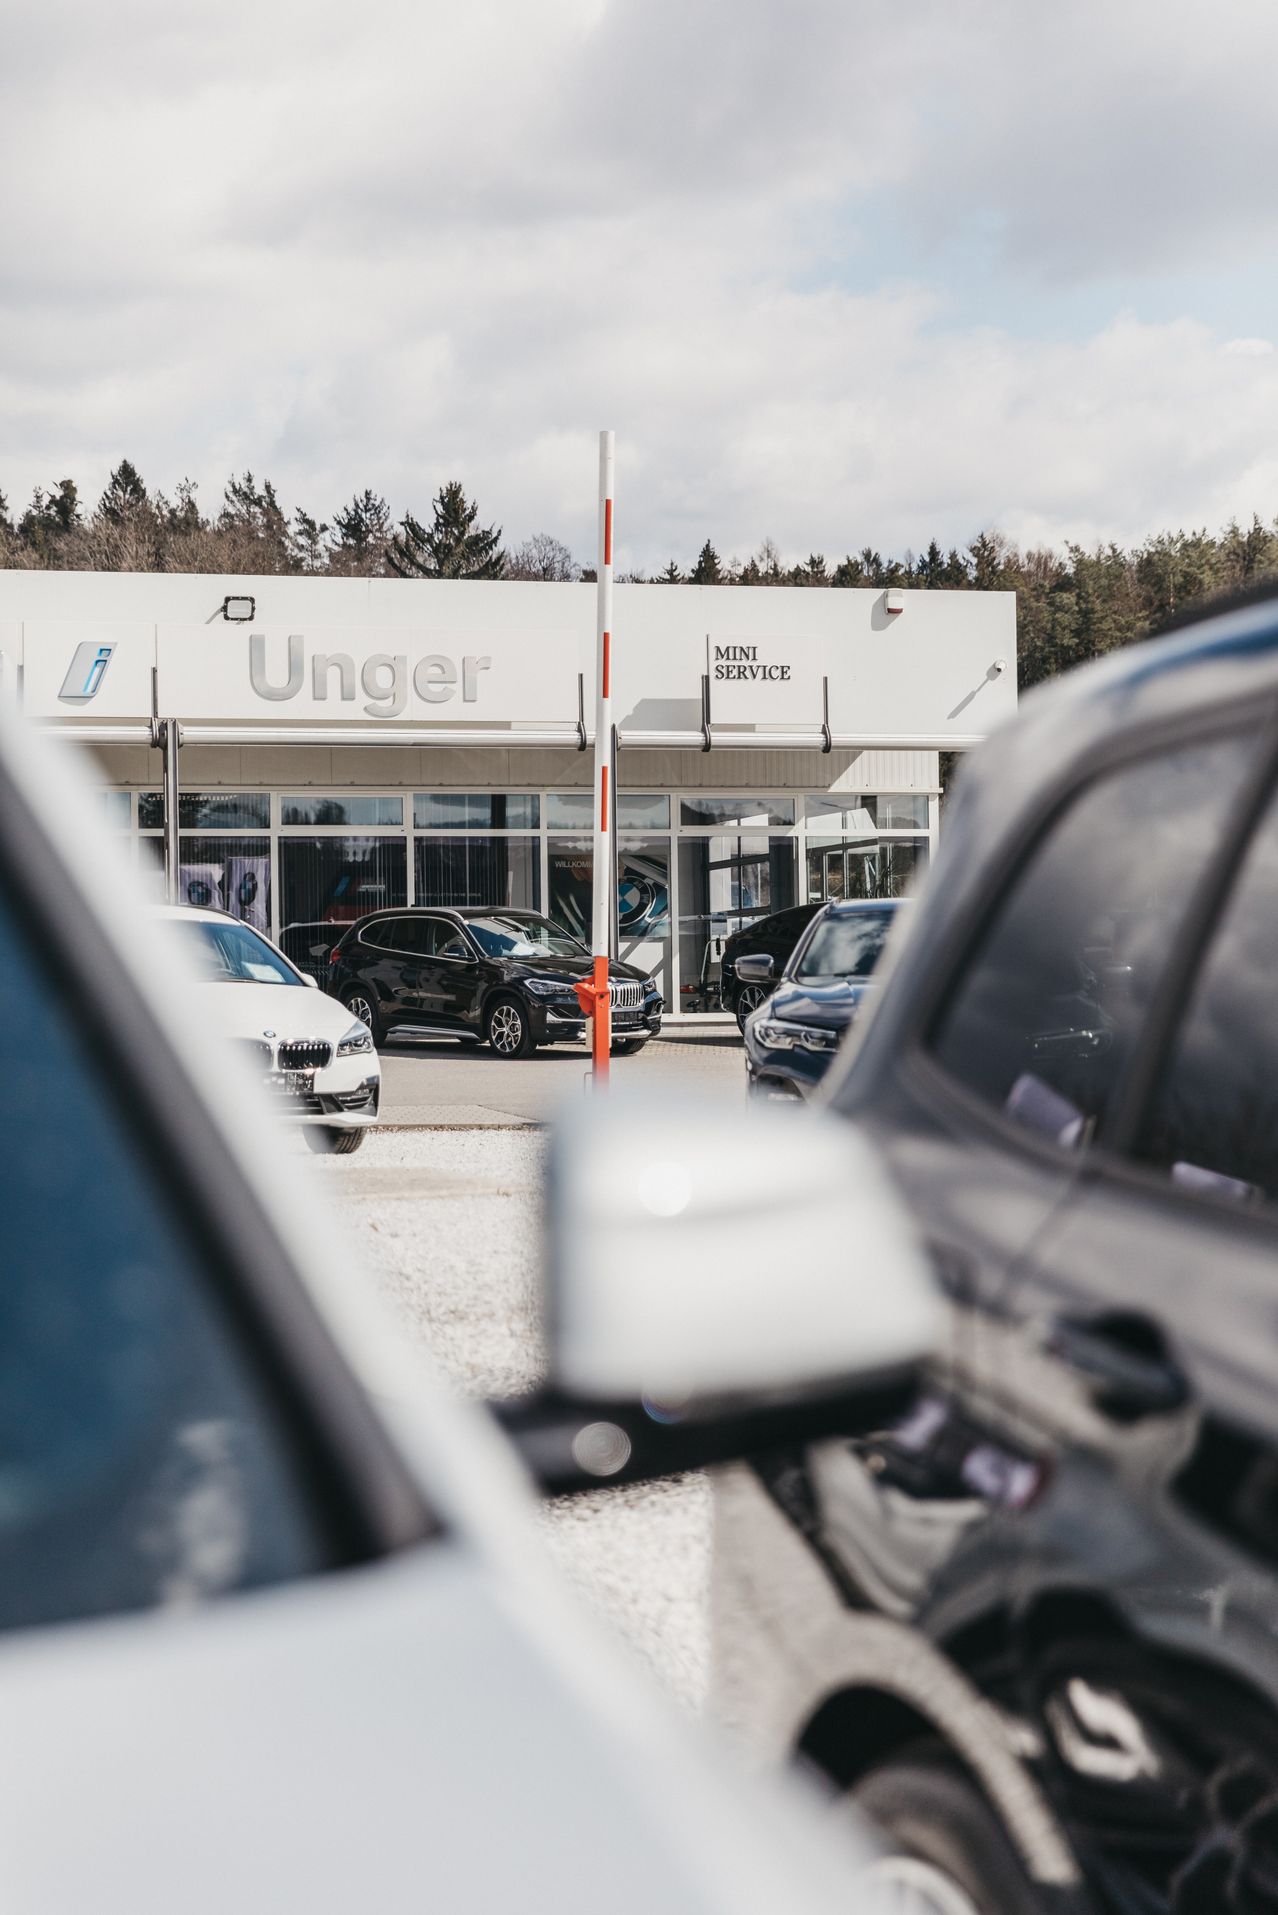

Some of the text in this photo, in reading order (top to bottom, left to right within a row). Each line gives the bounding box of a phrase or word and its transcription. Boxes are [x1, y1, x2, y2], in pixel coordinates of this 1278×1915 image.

[714, 645, 758, 661] MINI
[249, 634, 492, 718] Unger
[714, 664, 791, 680] SERVICE
